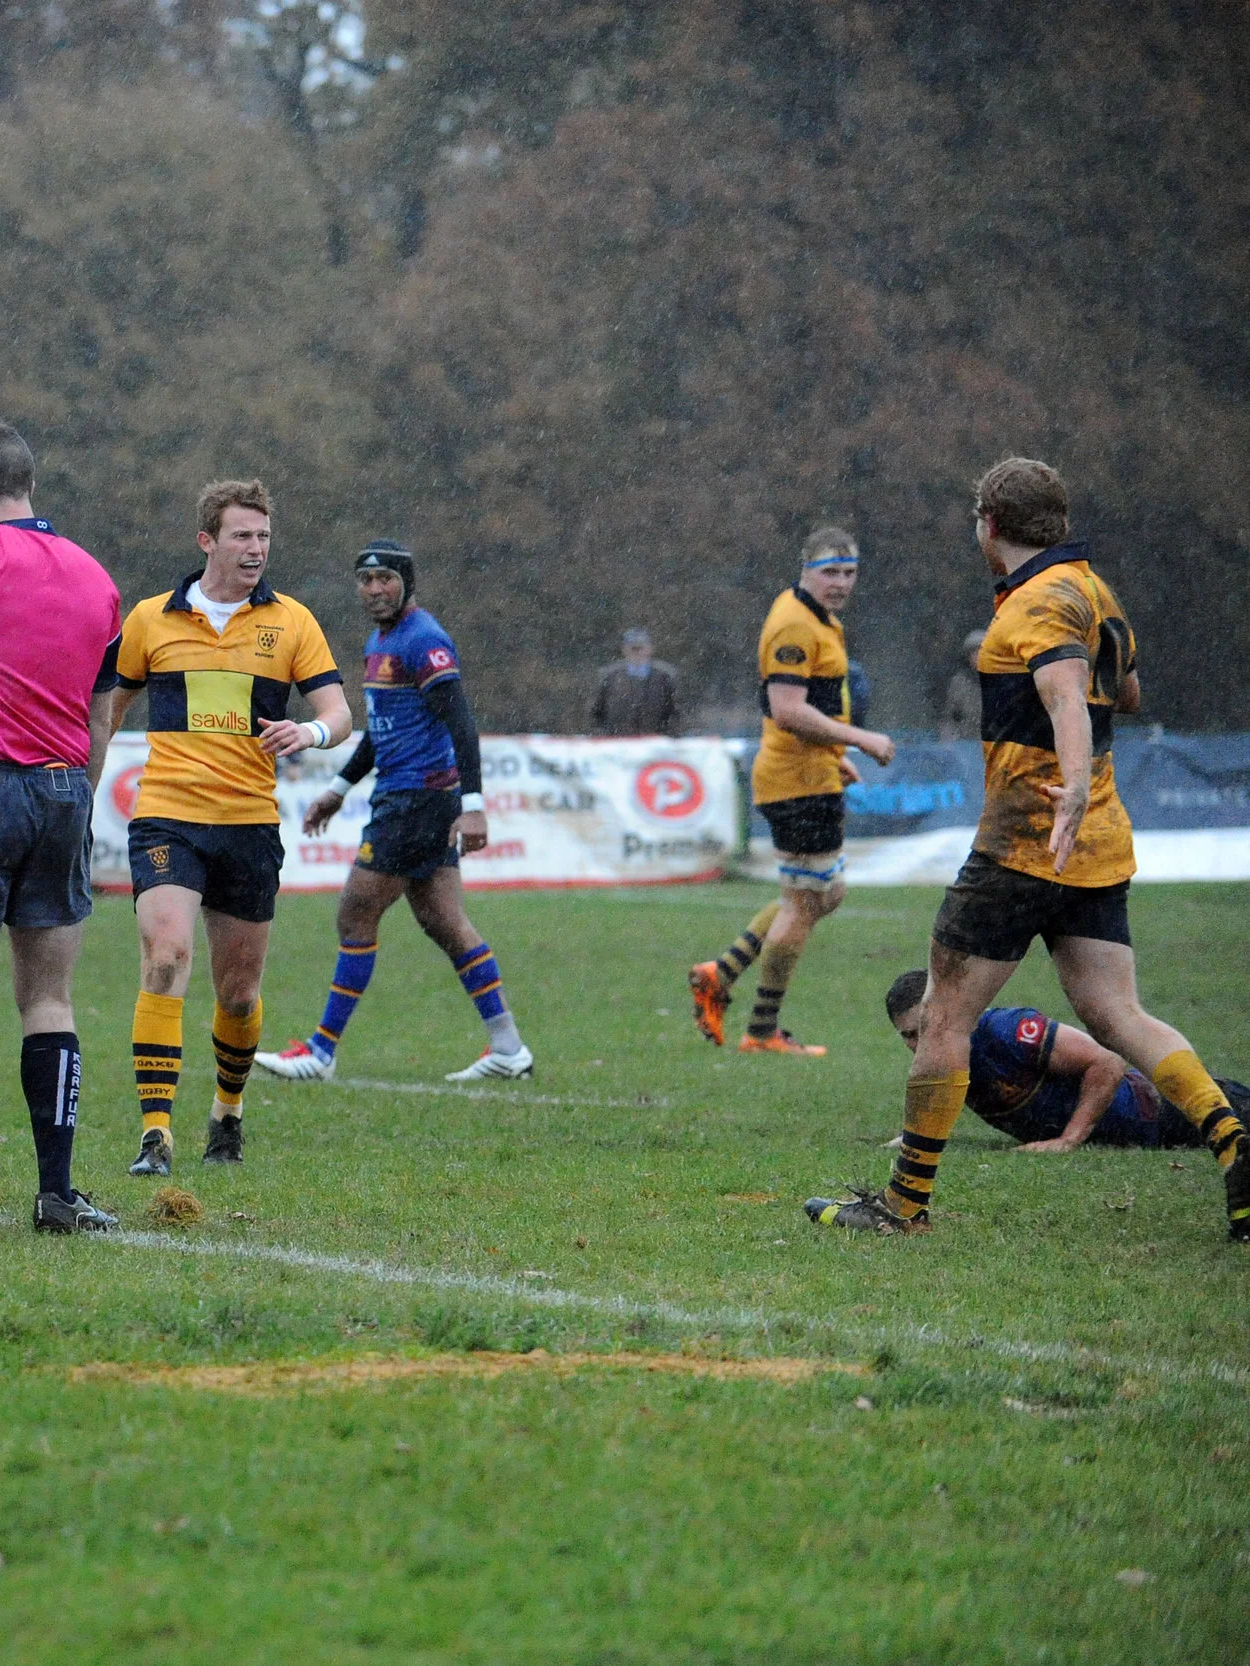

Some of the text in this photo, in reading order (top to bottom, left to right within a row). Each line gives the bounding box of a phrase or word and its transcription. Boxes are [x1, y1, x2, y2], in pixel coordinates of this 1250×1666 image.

[429, 650, 451, 669] IG
[191, 711, 249, 731] savills
[1020, 1021, 1040, 1045] IG
